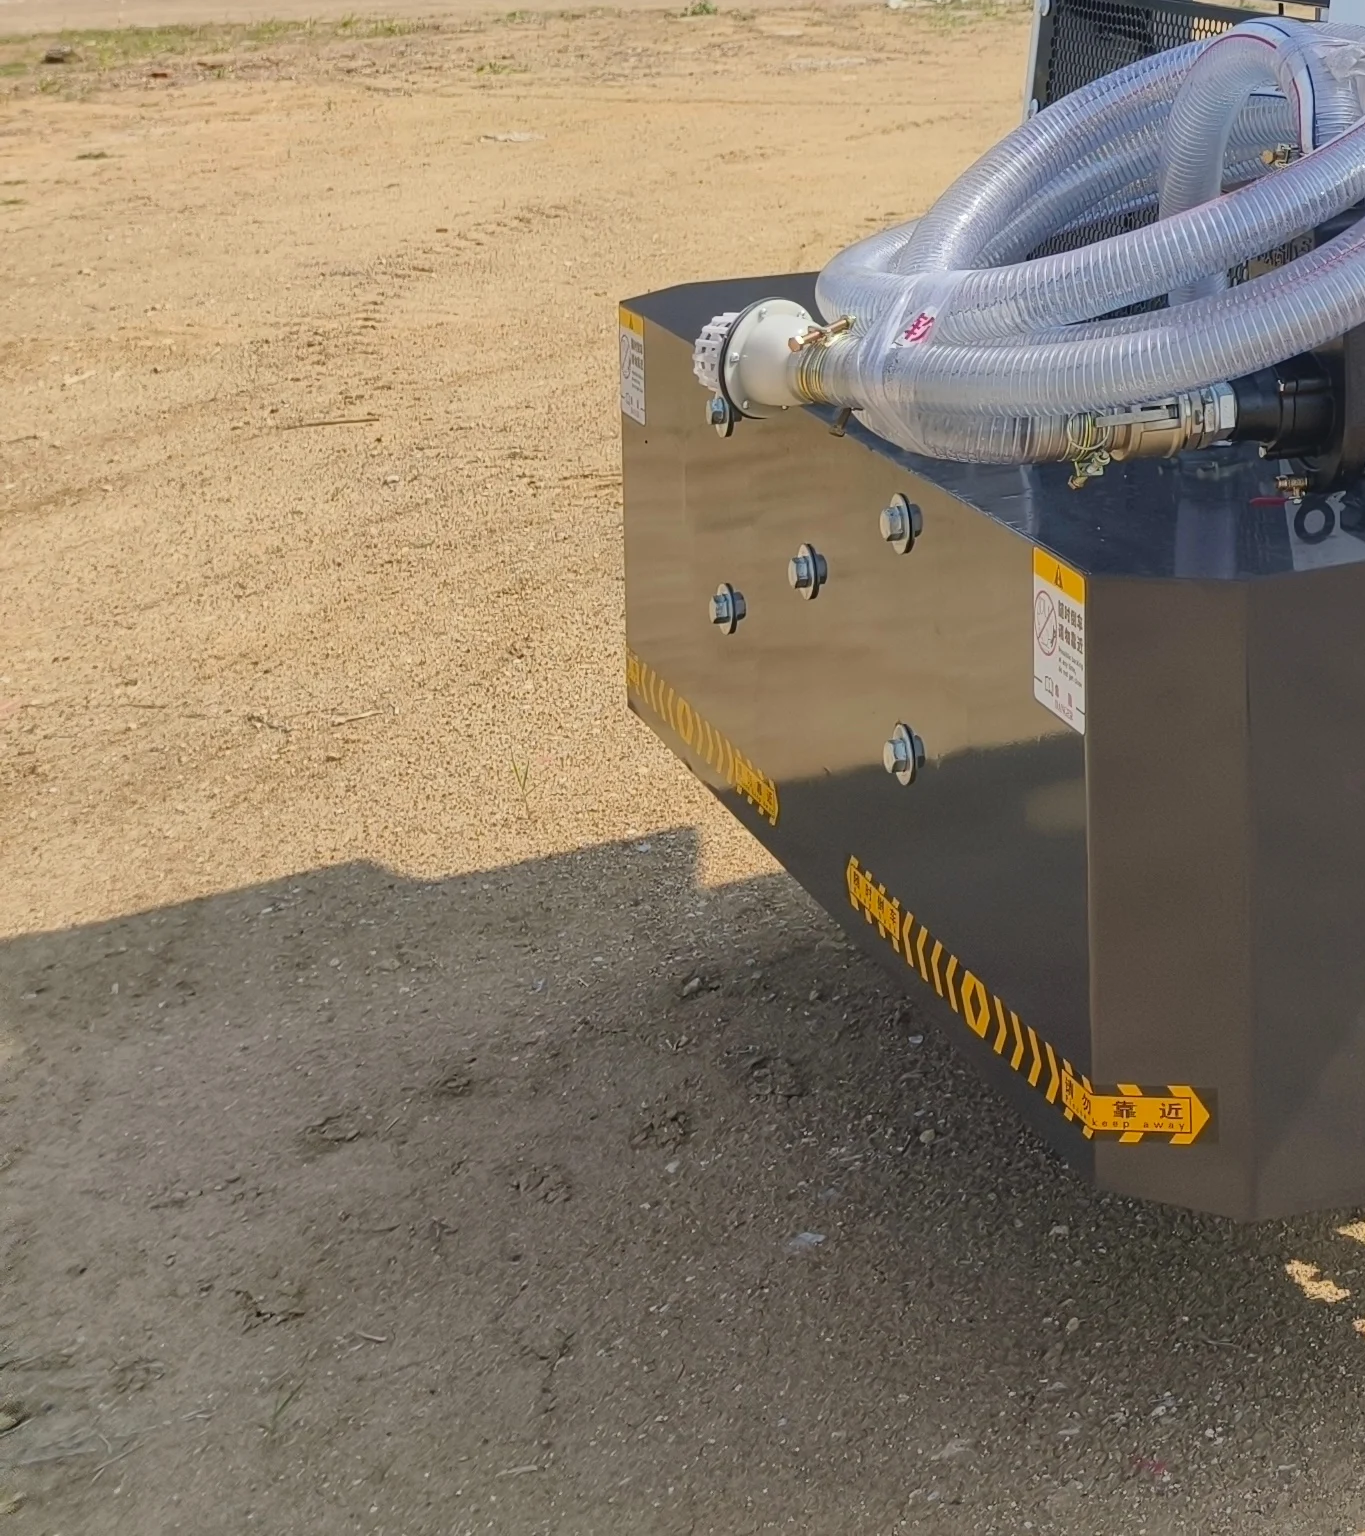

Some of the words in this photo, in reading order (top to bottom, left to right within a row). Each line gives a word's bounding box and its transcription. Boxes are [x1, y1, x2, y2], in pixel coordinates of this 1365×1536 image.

[1064, 1076, 1184, 1120] 请勿靠近
[1091, 1117, 1130, 1129] keep
[1143, 1121, 1185, 1131] away
